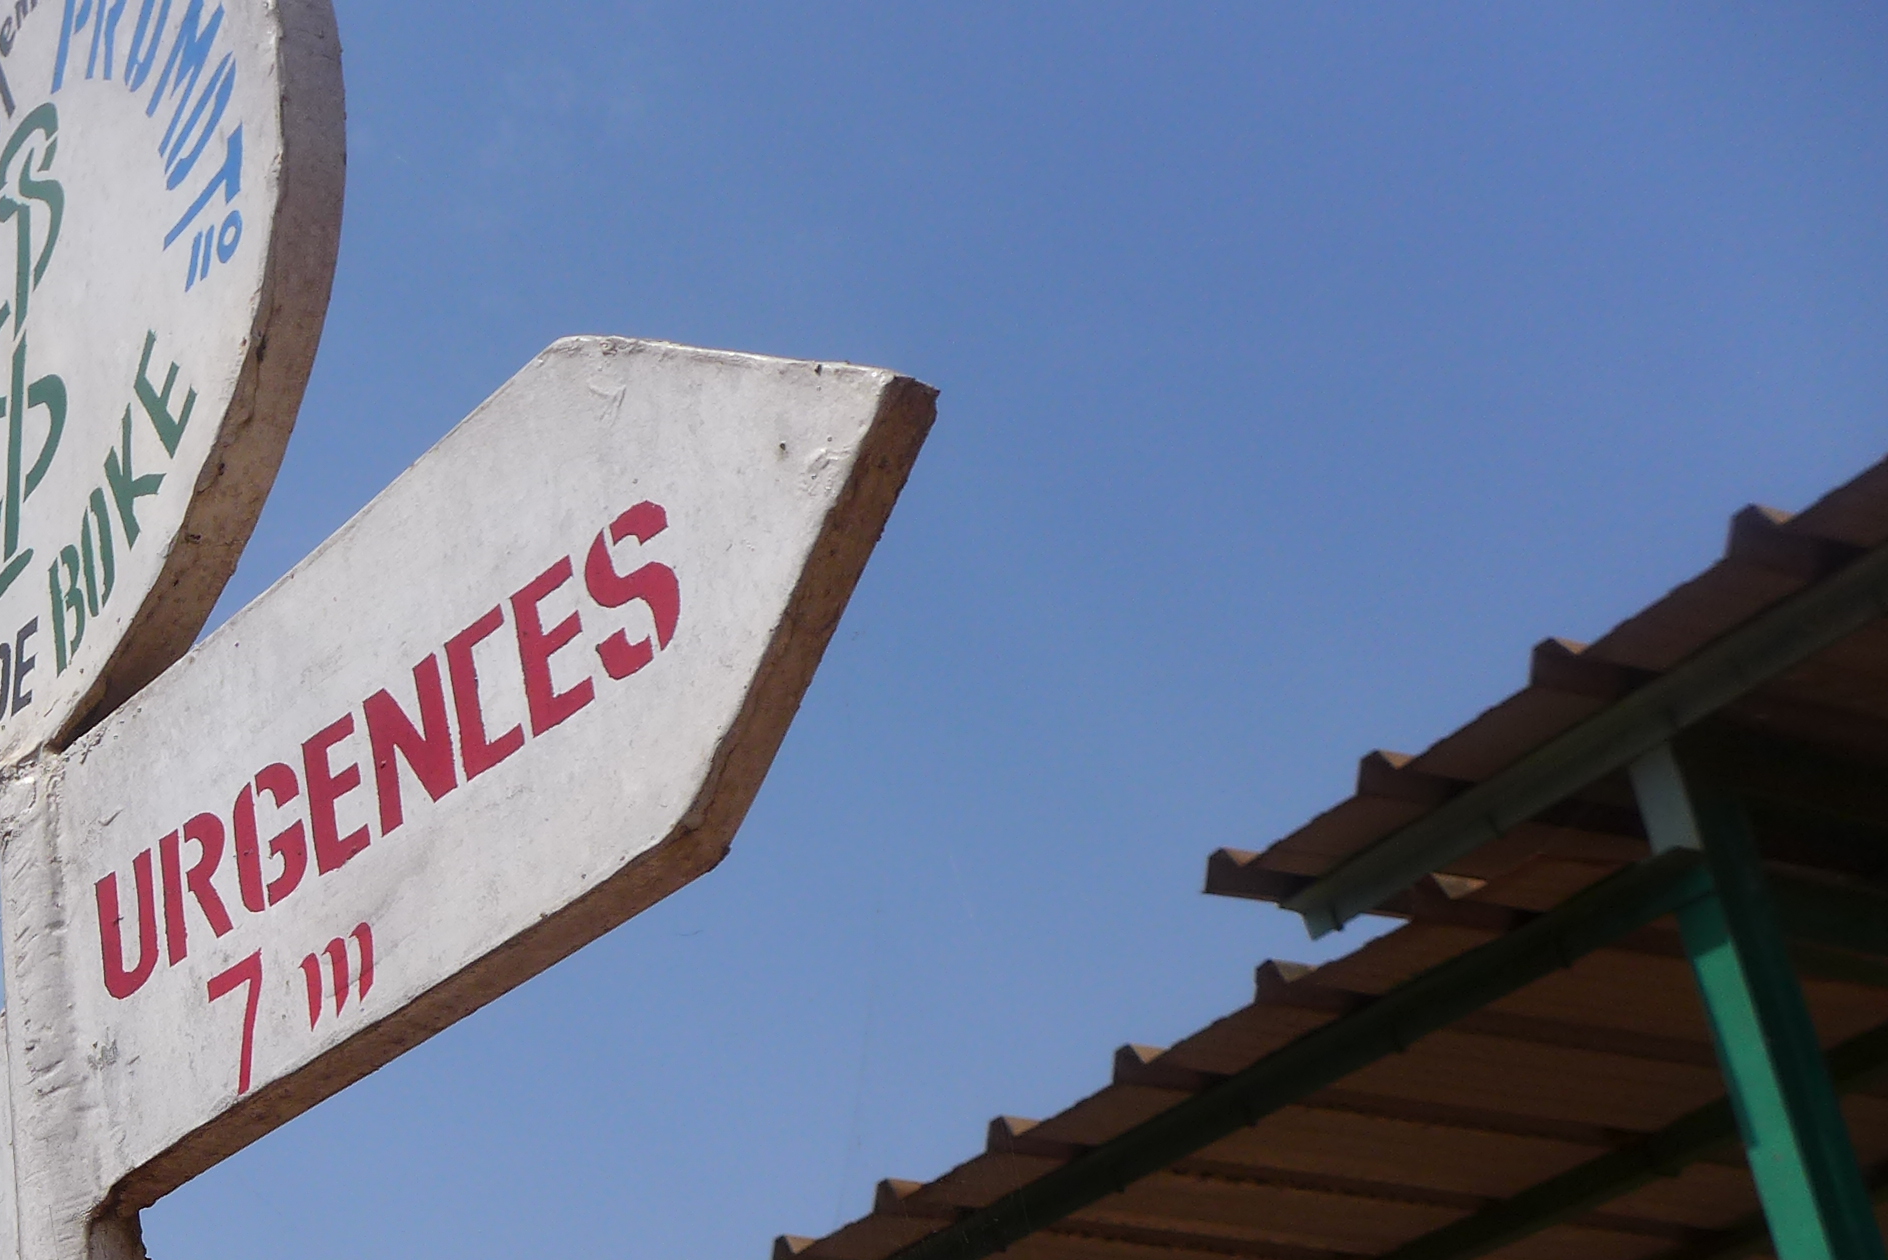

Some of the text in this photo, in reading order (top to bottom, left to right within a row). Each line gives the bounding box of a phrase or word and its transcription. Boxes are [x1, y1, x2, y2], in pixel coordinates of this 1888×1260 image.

[48, 328, 197, 679] BOKE
[94, 500, 681, 999] URGENCES
[207, 946, 263, 1096] 7
